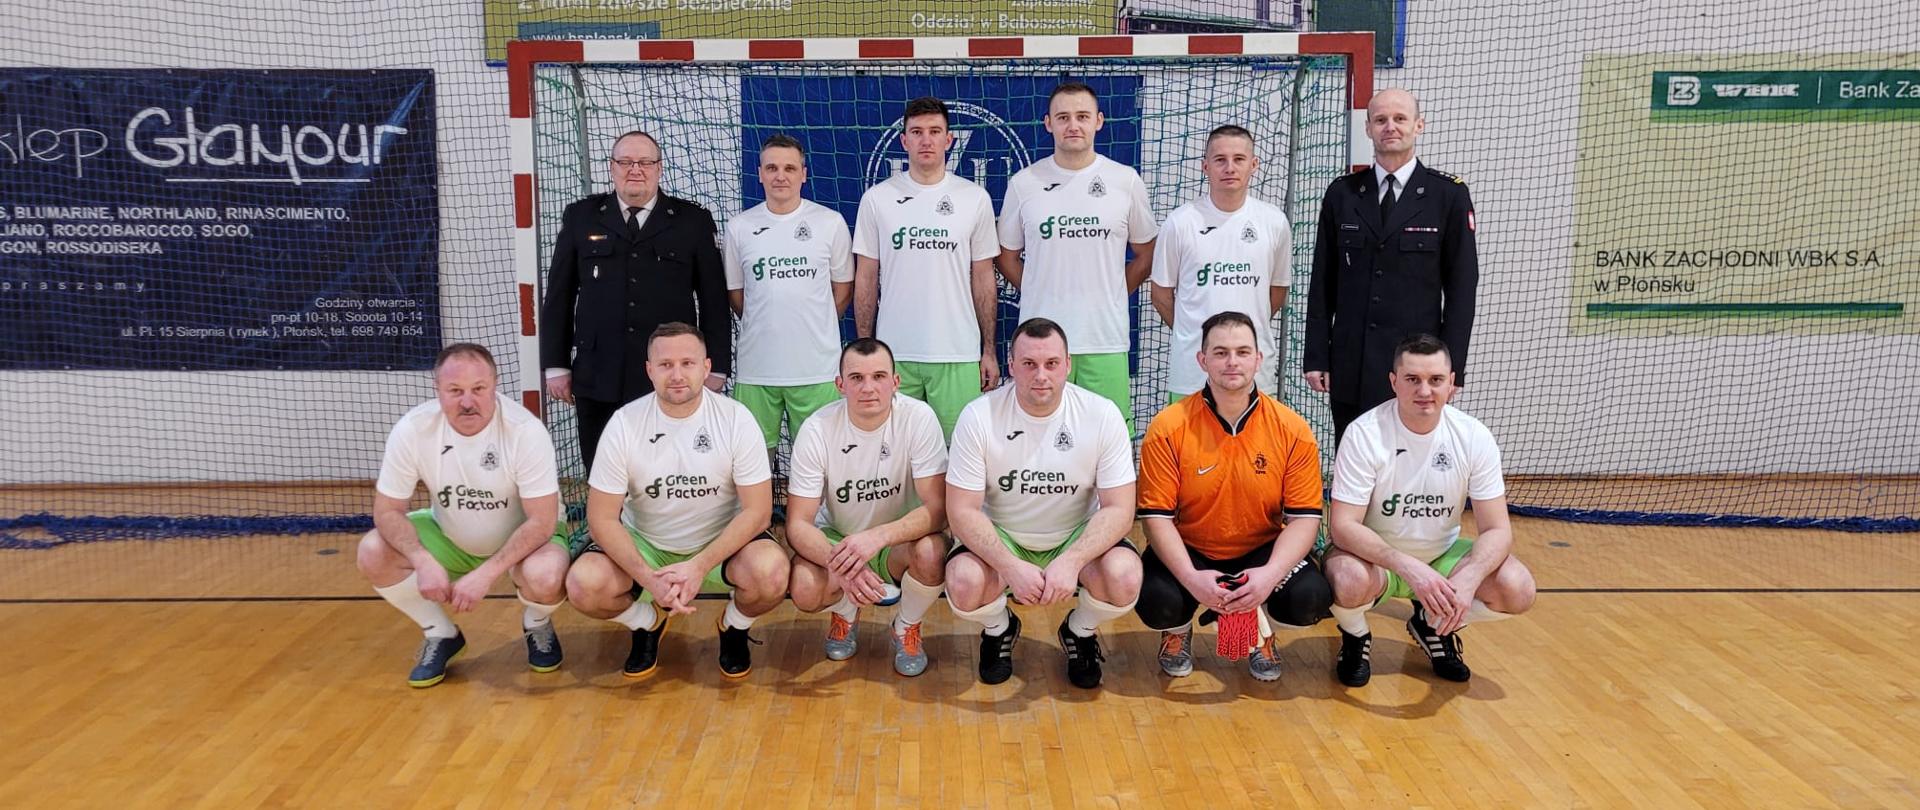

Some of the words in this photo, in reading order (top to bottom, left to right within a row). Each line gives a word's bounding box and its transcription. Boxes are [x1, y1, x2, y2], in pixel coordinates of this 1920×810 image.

[1840, 81, 1890, 98] Bank
[15, 207, 115, 222] BLUMARINE,
[118, 207, 222, 222] NORTHLAND,
[225, 207, 350, 222] RINASCIMENTO,
[1058, 215, 1100, 226] Green
[908, 226, 949, 237] Green
[1059, 227, 1111, 240] Factory
[909, 239, 958, 252] Factory
[768, 256, 808, 267] Green
[1595, 250, 1657, 267] BANK
[1662, 250, 1780, 267] ZACHODNI
[1787, 250, 1839, 267] WBK
[769, 267, 818, 280] Factory
[1213, 262, 1251, 273] Green
[1213, 274, 1261, 287] Factory
[1594, 279, 1610, 292] w
[315, 297, 364, 310] Godziny
[390, 311, 423, 322] 10-14
[159, 326, 174, 337] 15
[176, 326, 226, 339] Sierpnia
[351, 326, 374, 337] 698
[377, 326, 398, 337] 749
[401, 326, 423, 337] 654
[665, 475, 708, 487] Green
[1020, 469, 1066, 482] Green
[667, 485, 720, 499] Factory
[1020, 483, 1079, 495] Factory
[457, 498, 509, 511] Factory
[1402, 506, 1454, 518] Factory
